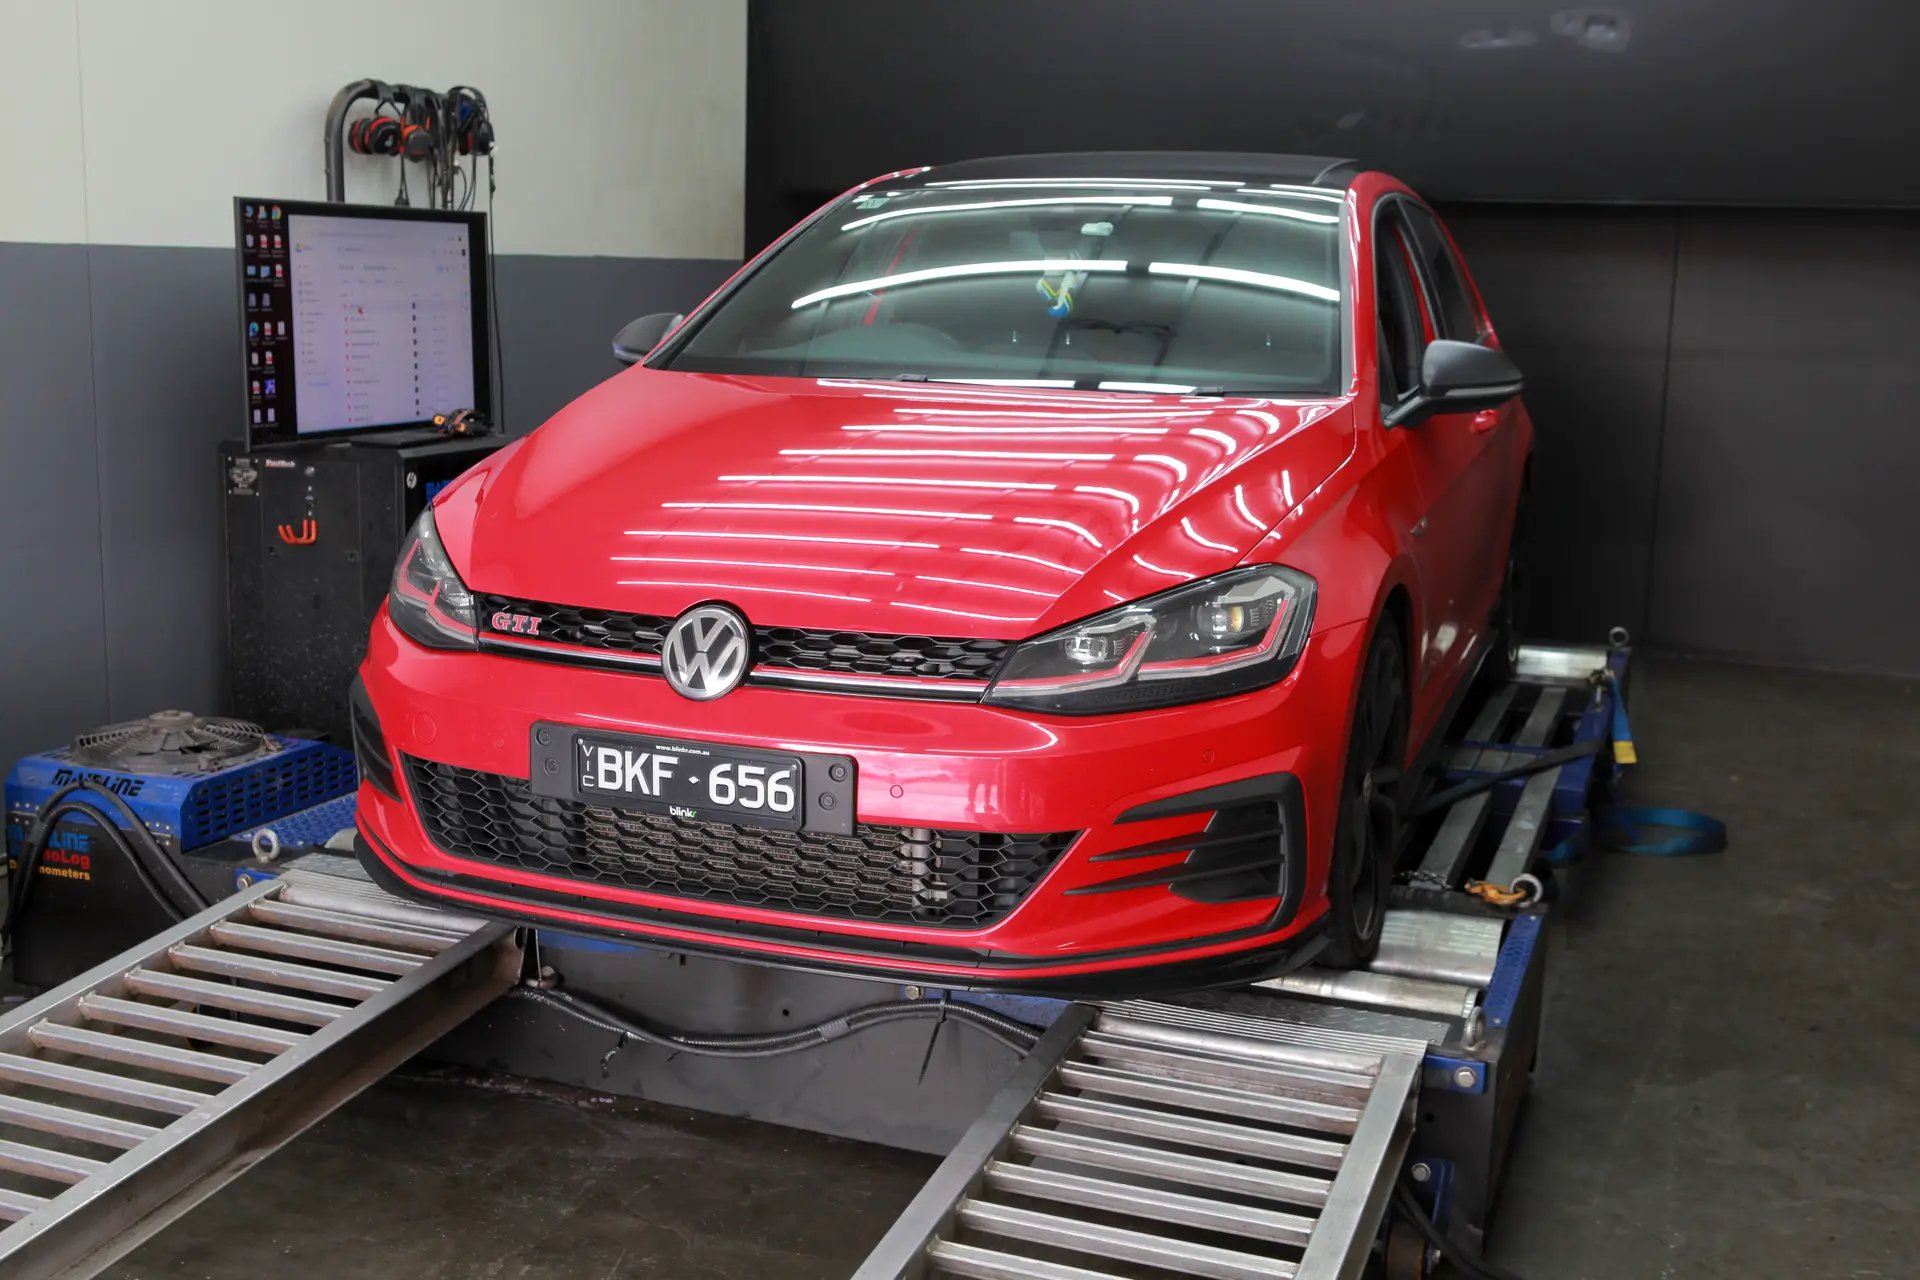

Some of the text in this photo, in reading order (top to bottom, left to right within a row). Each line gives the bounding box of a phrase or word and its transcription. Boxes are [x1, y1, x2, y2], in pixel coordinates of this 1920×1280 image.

[492, 612, 541, 635] GTI
[655, 745, 710, 756] www.blinkr.com.au
[582, 745, 594, 787] VIC
[597, 747, 796, 813] BKF 656
[669, 805, 698, 818] blinkr
